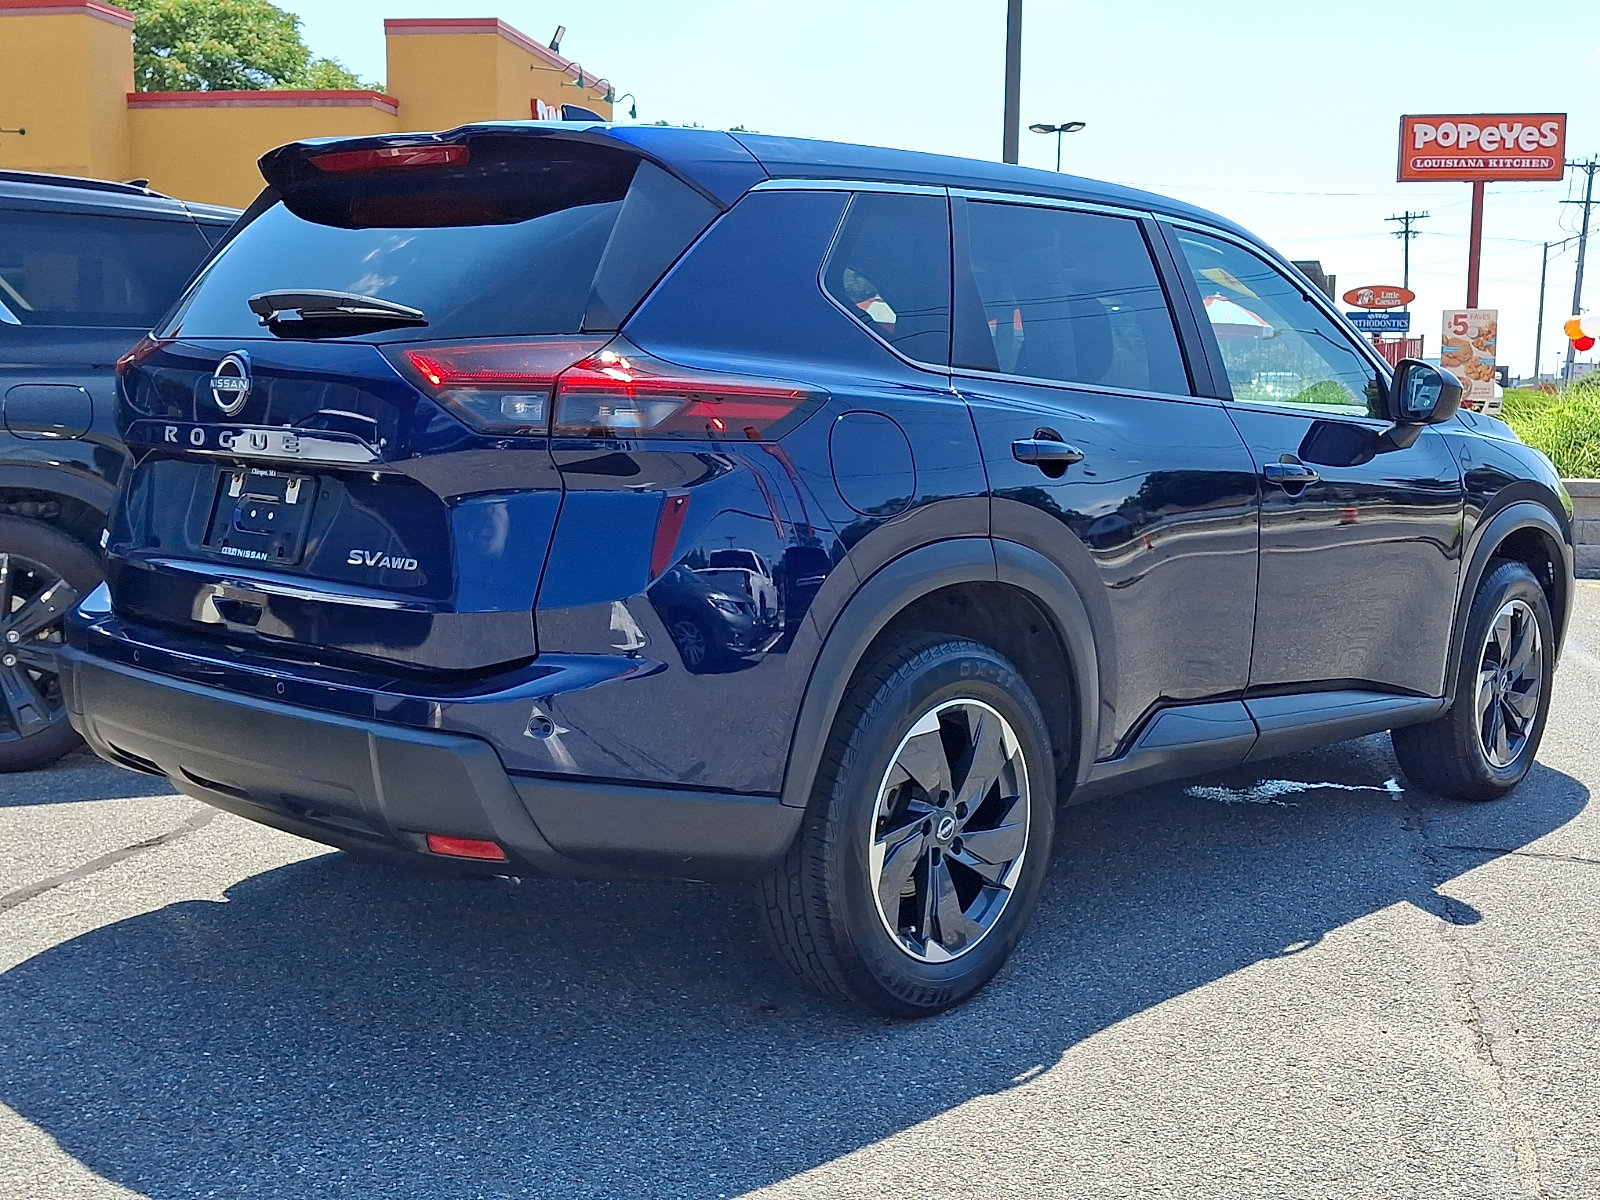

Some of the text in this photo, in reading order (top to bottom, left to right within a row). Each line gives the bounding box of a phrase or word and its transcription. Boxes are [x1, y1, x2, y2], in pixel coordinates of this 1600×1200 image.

[1416, 158, 1550, 168] LOUISIANA KITCHEN
[1381, 291, 1400, 299] Little
[1352, 319, 1408, 327] RTHODONTICS
[210, 379, 248, 389] NISSAN
[164, 425, 300, 453] ROGUE
[237, 548, 268, 560] NISSAN
[347, 549, 418, 571] SV AWD
